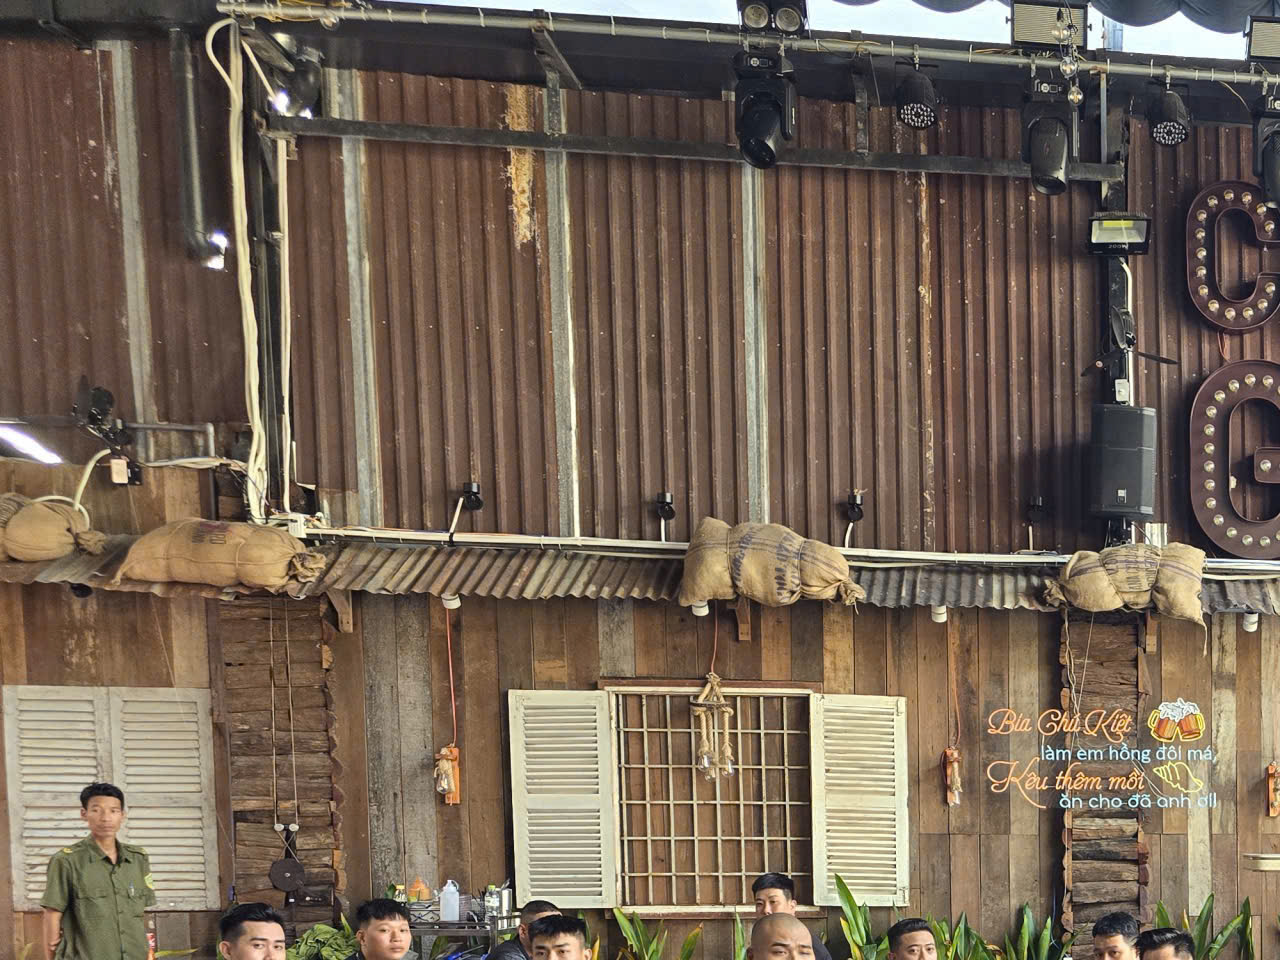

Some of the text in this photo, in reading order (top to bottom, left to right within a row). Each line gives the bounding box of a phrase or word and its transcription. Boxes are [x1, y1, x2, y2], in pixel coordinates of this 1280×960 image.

[987, 708, 1032, 735] Bia
[1083, 708, 1132, 744] Kiệt
[1040, 745, 1071, 761] làm
[1076, 748, 1103, 761] em
[1108, 743, 1151, 764] hồng
[986, 756, 1048, 809] Kêu
[1055, 762, 1102, 790] thêm
[1059, 793, 1083, 809] ăn
[1088, 793, 1123, 809] cho
[1127, 793, 1152, 809] đã
[1156, 793, 1191, 809] anh
